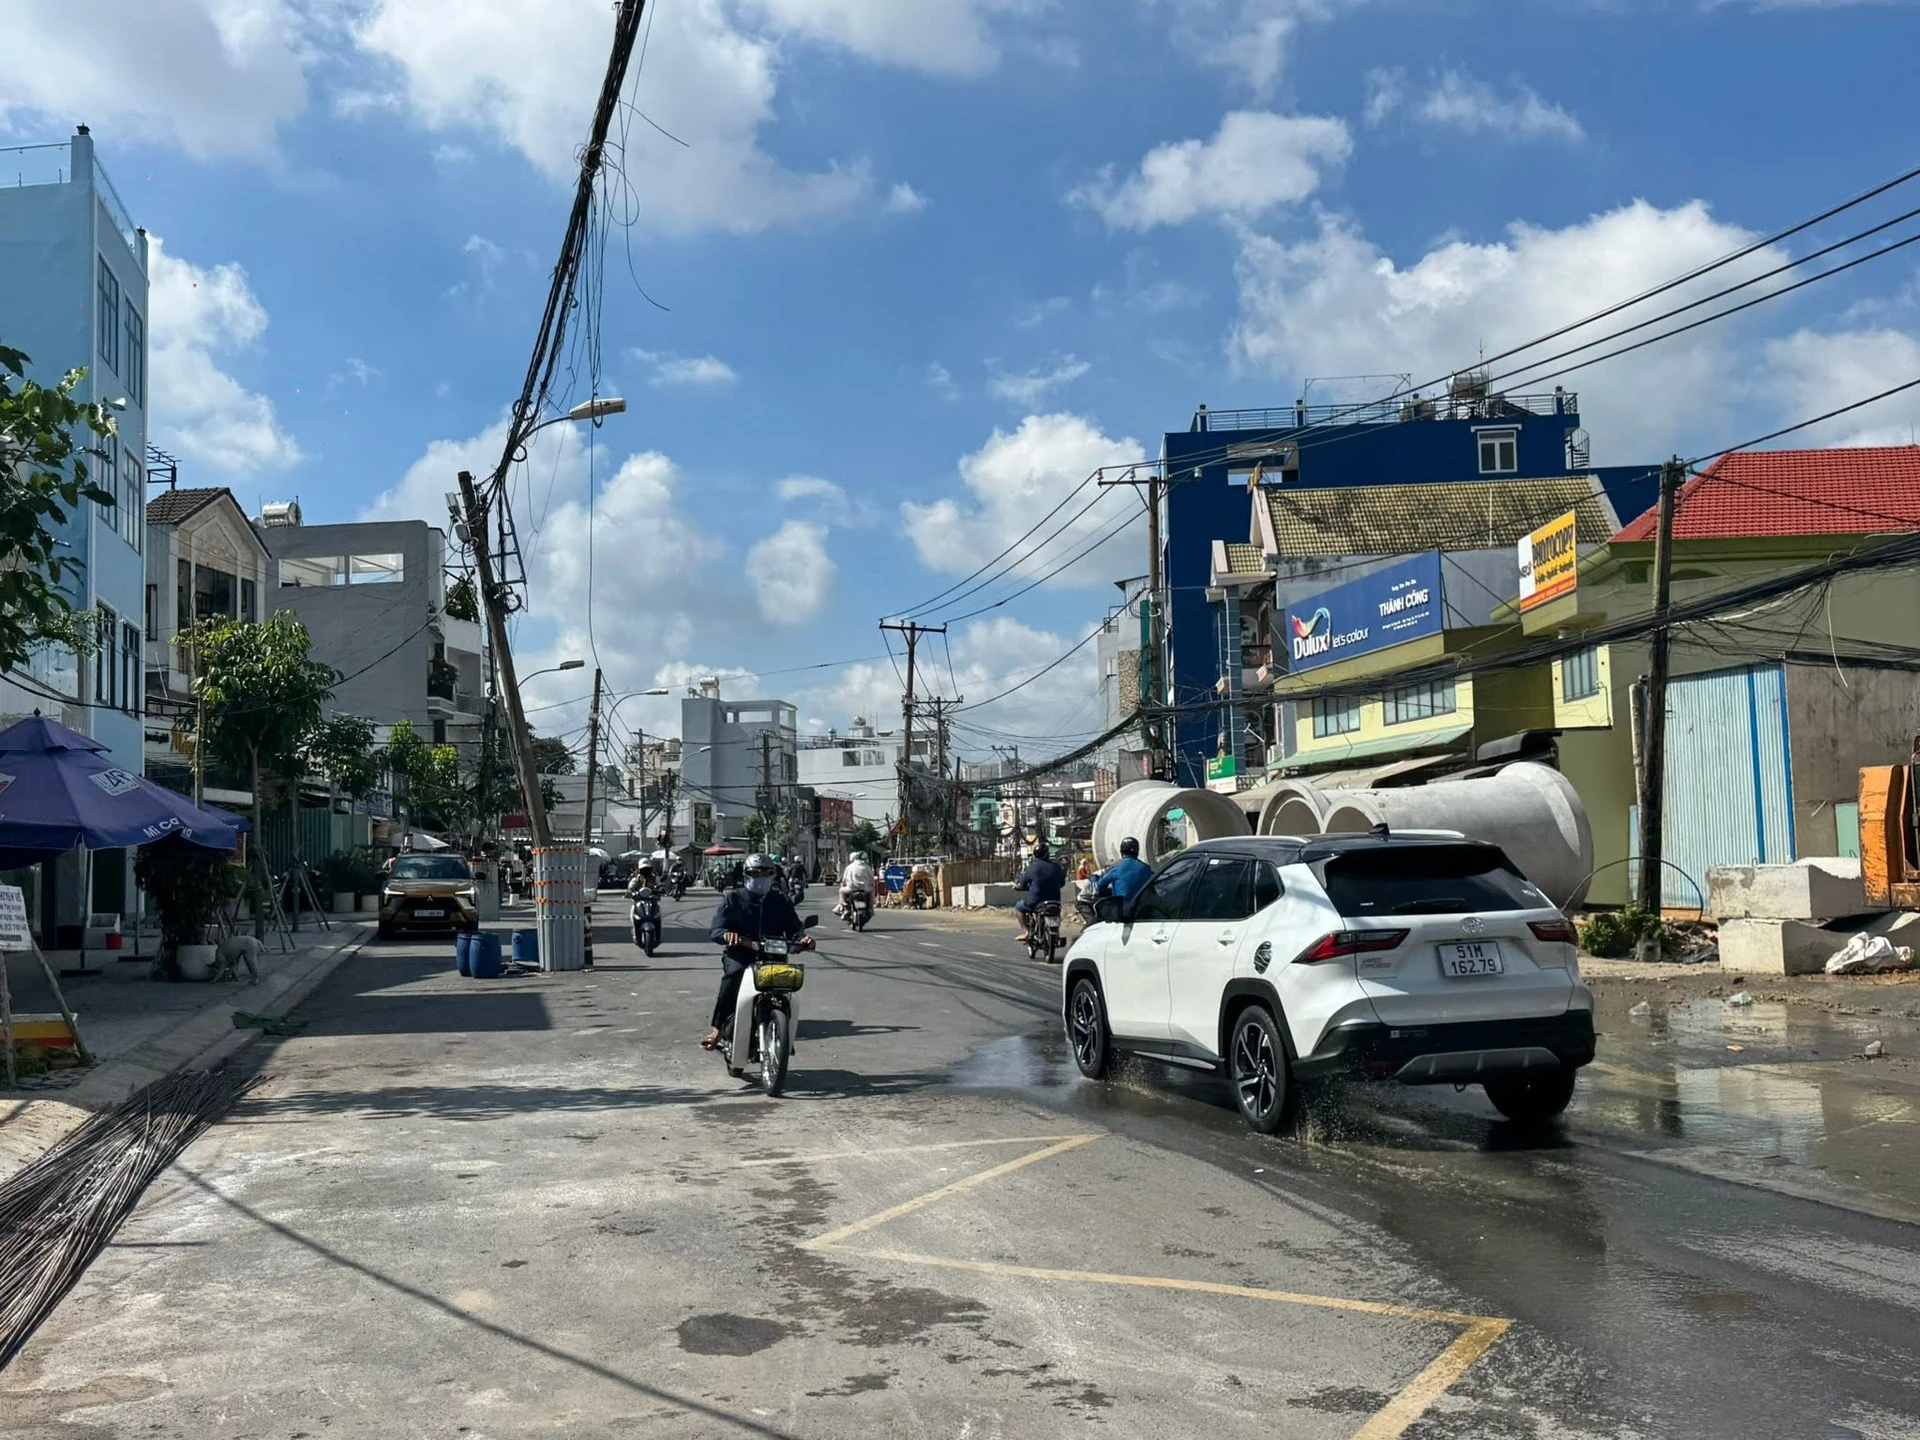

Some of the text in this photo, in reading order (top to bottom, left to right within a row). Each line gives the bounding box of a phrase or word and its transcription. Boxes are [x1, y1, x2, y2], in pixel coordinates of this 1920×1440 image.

[1346, 627, 1370, 643] colour
[1293, 632, 1329, 660] Dulux
[1457, 945, 1483, 959] 51M
[1451, 959, 1496, 974] 162.79
